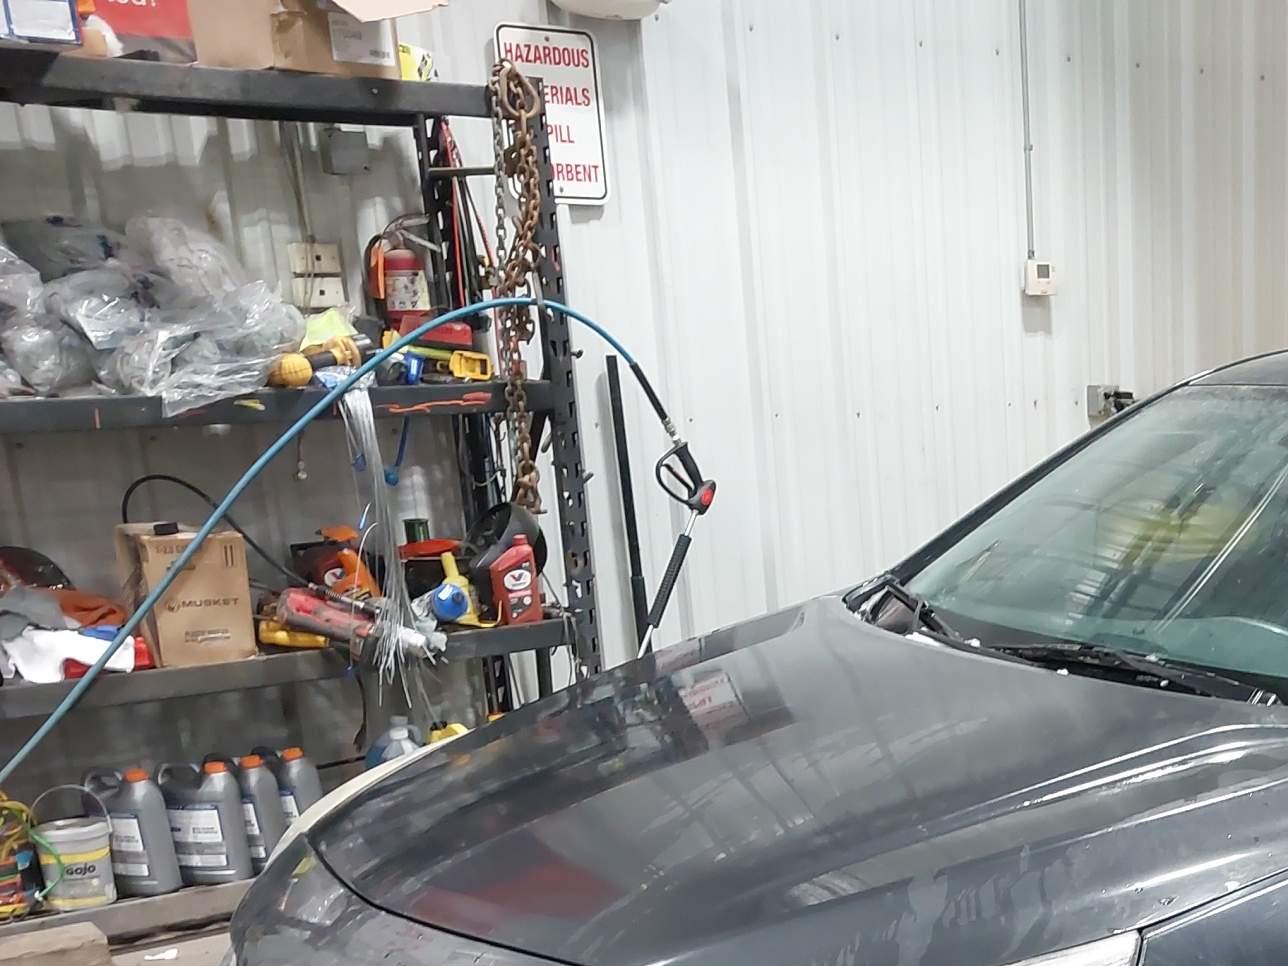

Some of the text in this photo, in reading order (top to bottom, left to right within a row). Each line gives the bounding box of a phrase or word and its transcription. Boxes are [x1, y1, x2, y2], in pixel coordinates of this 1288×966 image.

[503, 42, 590, 68] HAZARDOUS
[543, 85, 591, 107] ERIALS
[546, 124, 575, 144] PILL
[181, 597, 239, 608] MUSKET
